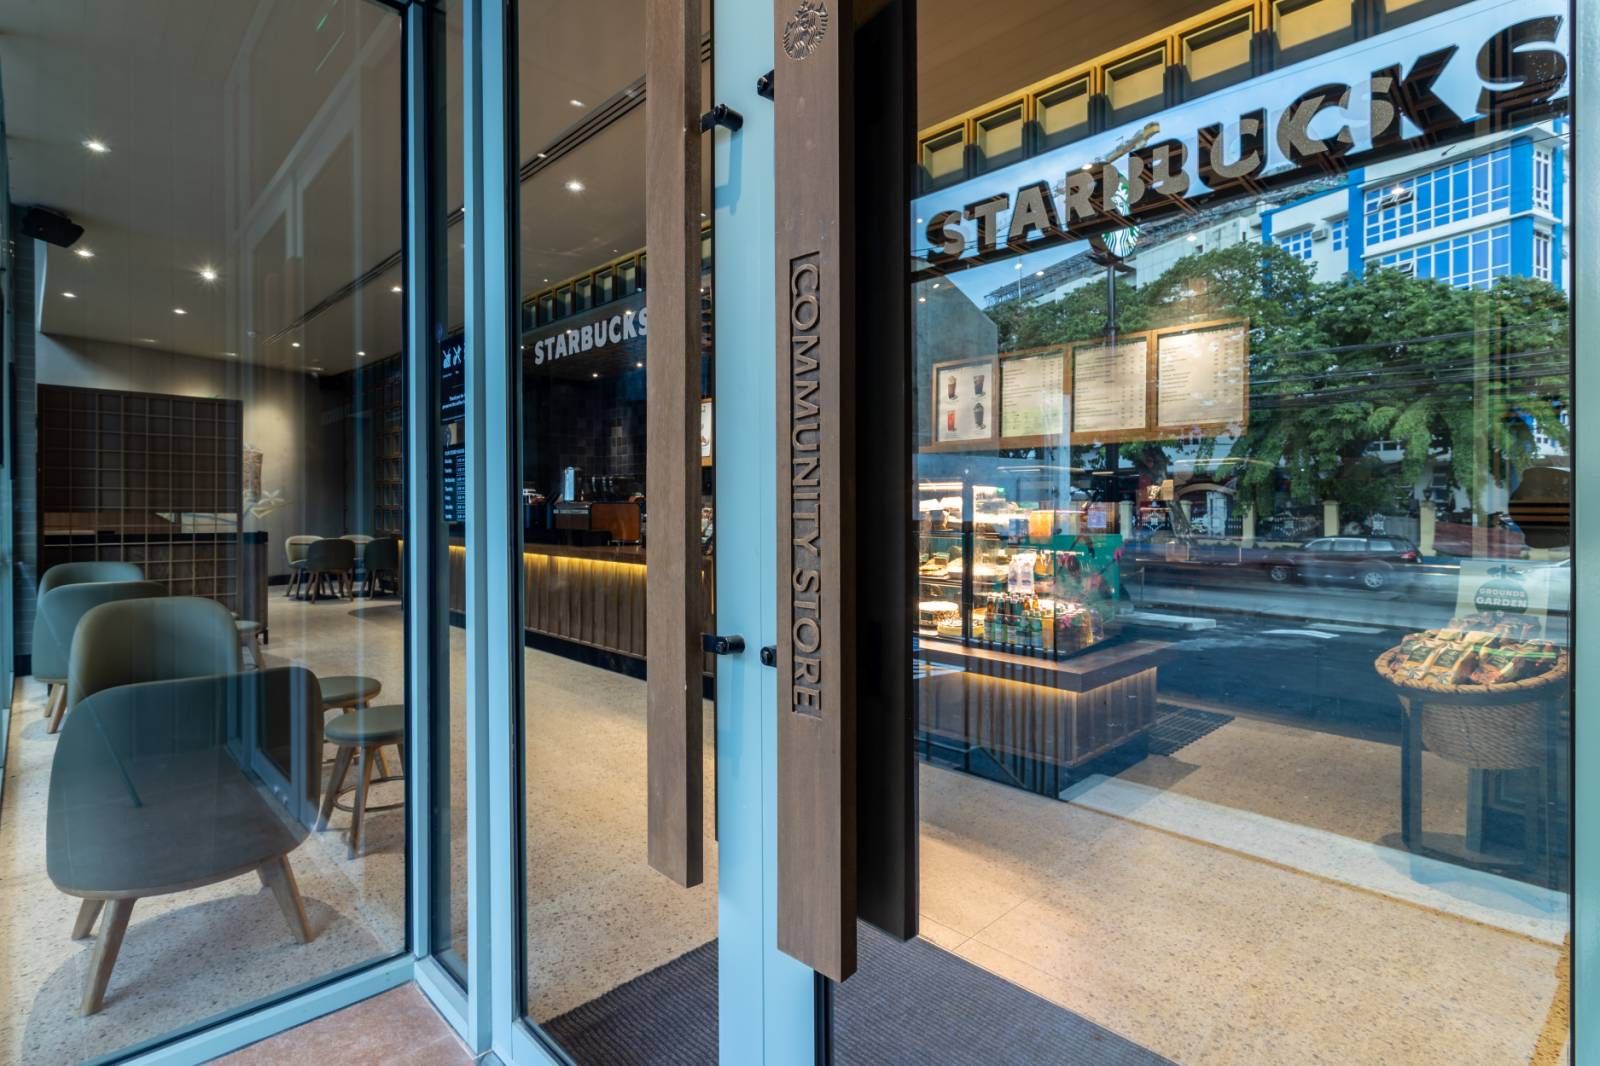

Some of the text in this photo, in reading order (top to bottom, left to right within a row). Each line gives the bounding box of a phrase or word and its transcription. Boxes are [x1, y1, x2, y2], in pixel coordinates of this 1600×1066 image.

[926, 15, 1570, 259] STARBUCKS
[534, 306, 647, 365] STARBUCKS
[791, 262, 821, 710] COMMUNITY STORE
[1476, 596, 1528, 608] GARDEN
[1479, 587, 1525, 598] GROUNDS
